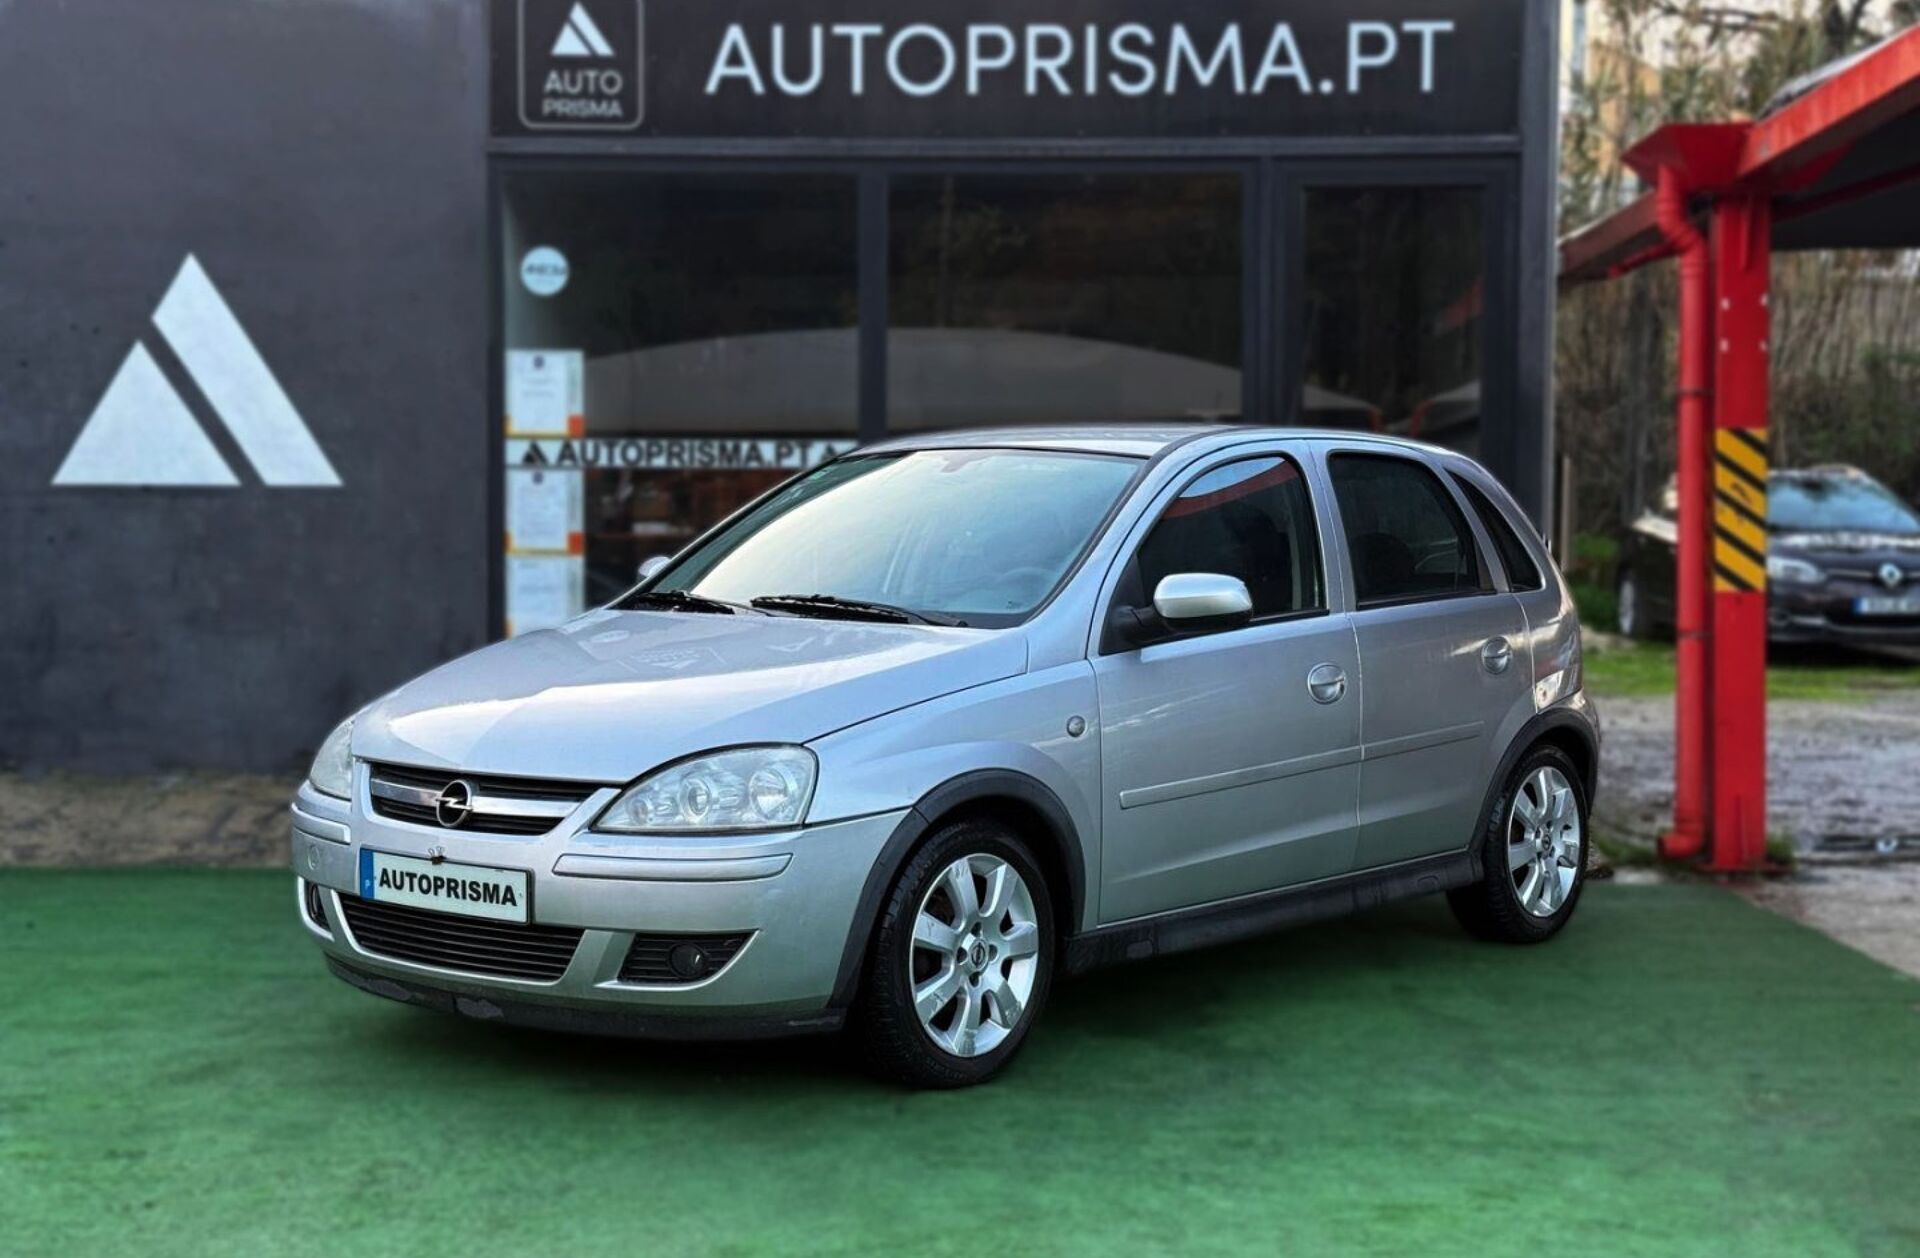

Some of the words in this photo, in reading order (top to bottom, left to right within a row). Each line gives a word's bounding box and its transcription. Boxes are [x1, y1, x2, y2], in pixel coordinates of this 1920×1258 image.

[704, 21, 1455, 95] AUTOPRISMA.PT
[543, 69, 623, 95] AUTO
[542, 99, 623, 118] PRISMA
[557, 440, 814, 467] AUTOPRISMA.PT
[379, 868, 517, 906] AUTOPRISMA
